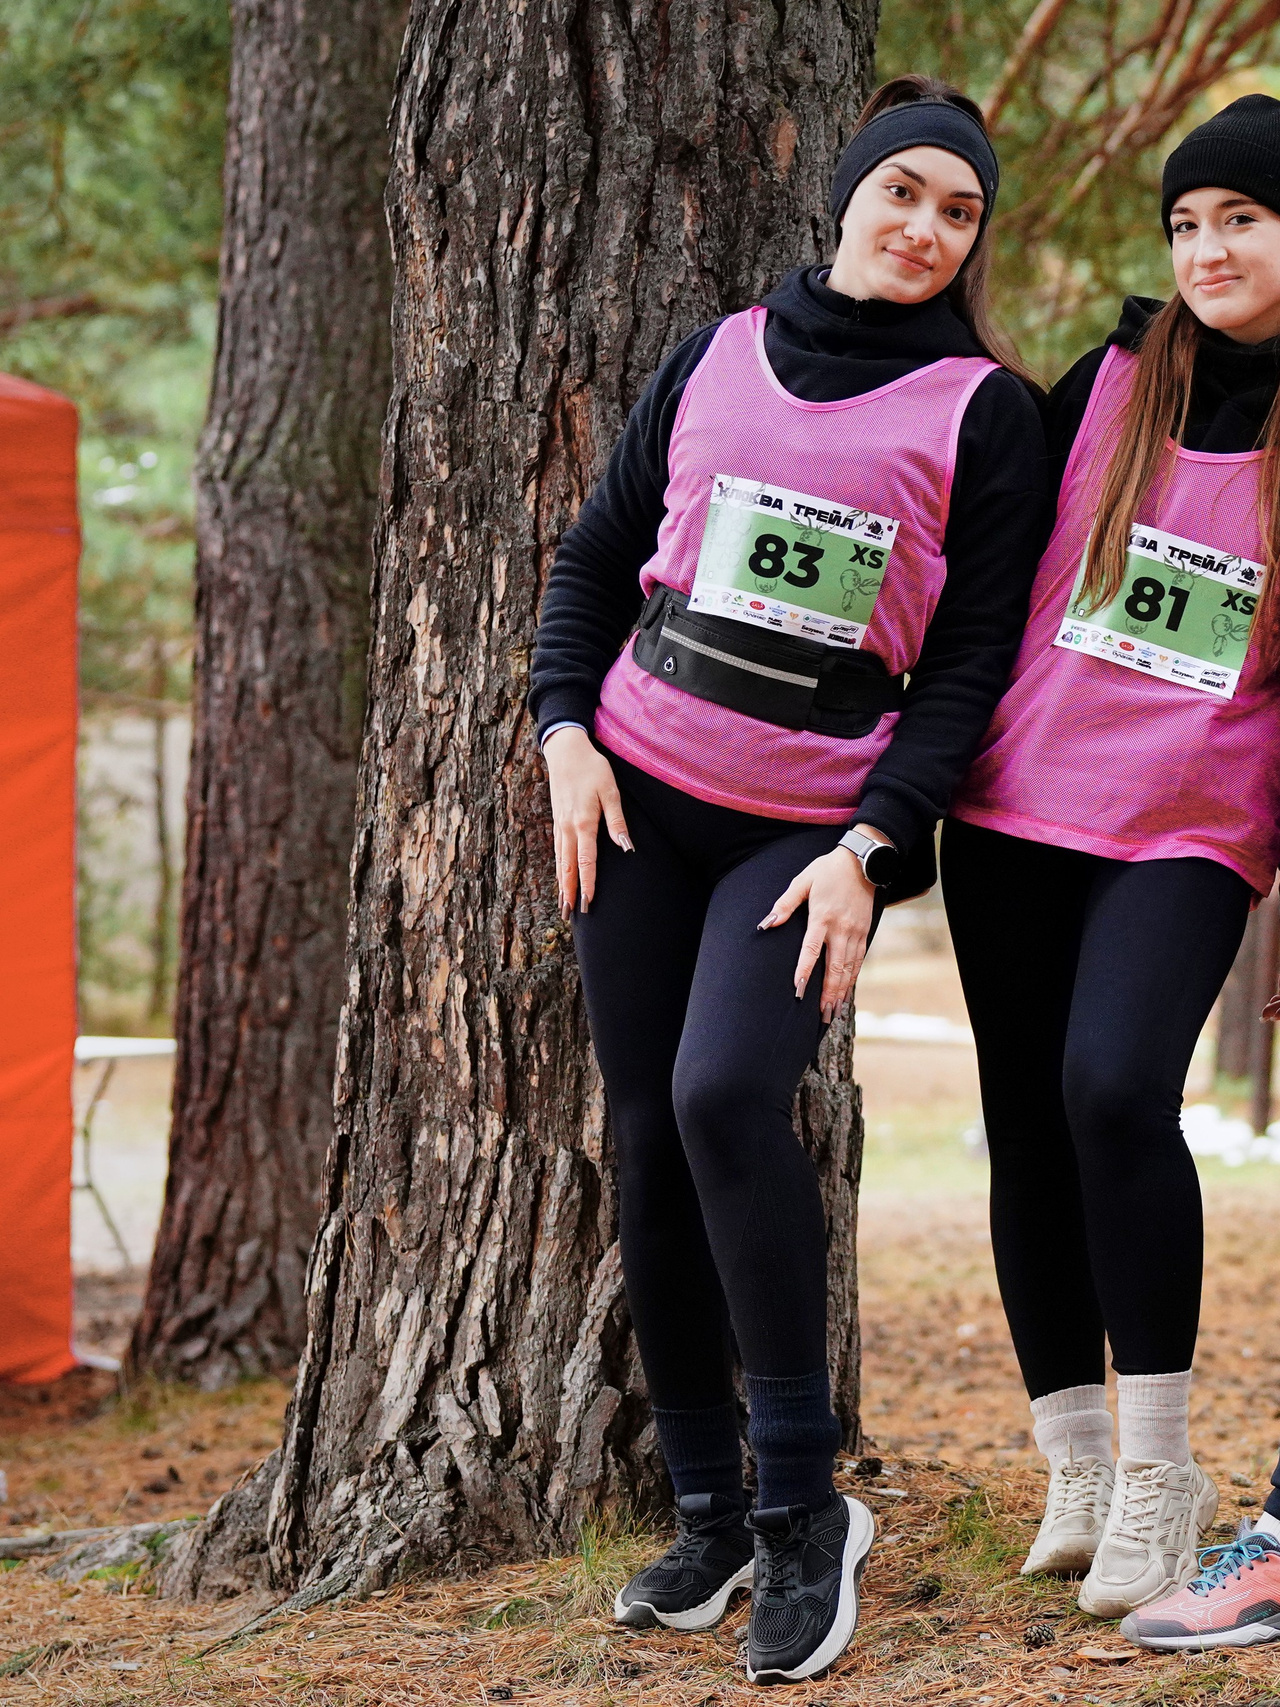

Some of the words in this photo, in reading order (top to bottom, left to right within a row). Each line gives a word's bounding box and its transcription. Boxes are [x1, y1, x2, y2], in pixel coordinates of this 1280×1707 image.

[719, 487, 783, 510] КЛЮКВА
[794, 503, 854, 530] ТРЕЙЛ
[748, 534, 824, 588] 83
[849, 544, 885, 569] XS
[1168, 545, 1229, 575] ТРЕЙЛ
[1125, 576, 1190, 631] 81
[1221, 589, 1257, 615] XS
[1199, 678, 1224, 689] JORDA
